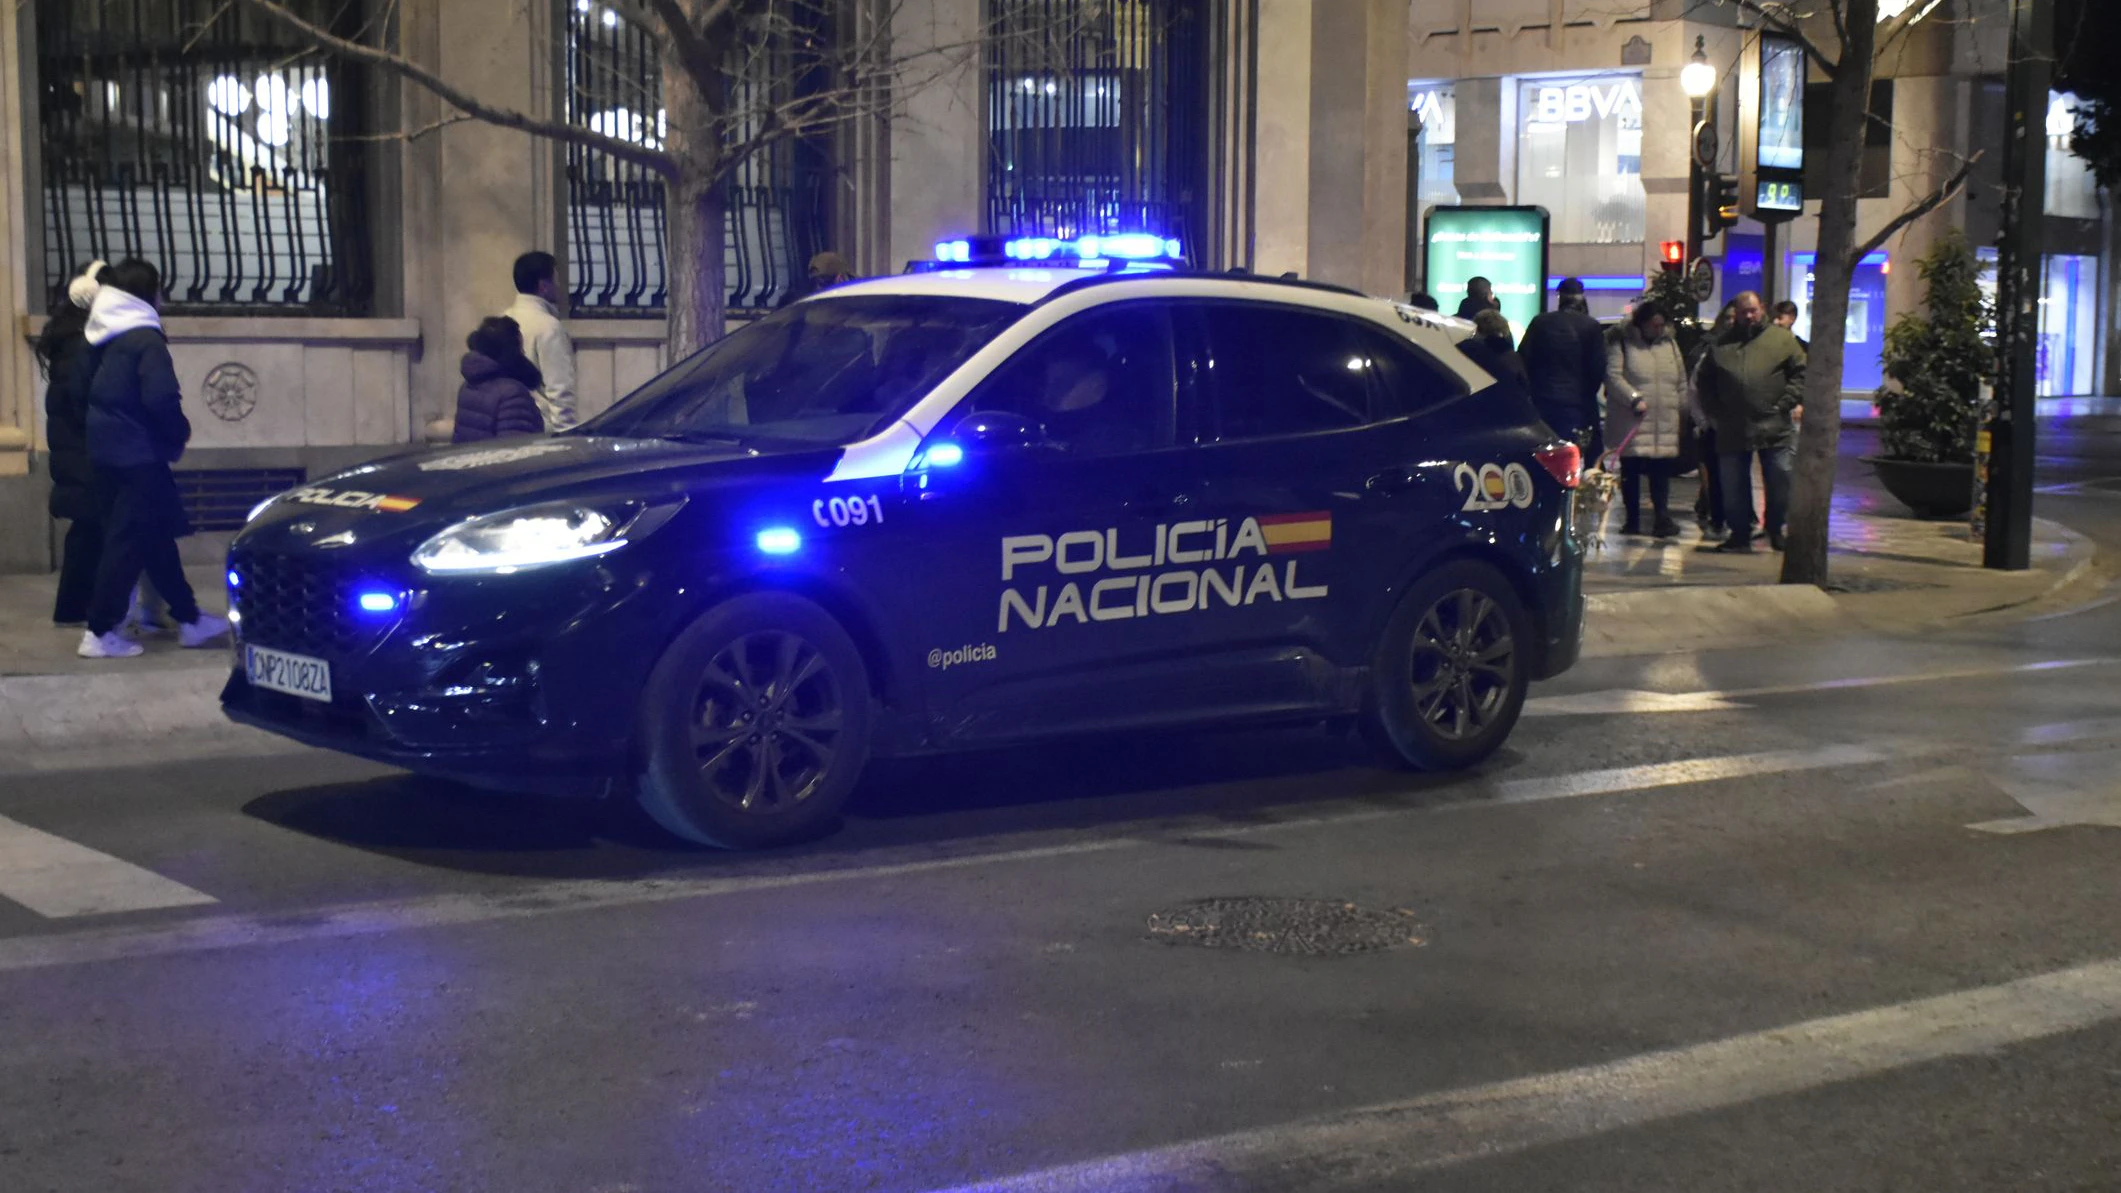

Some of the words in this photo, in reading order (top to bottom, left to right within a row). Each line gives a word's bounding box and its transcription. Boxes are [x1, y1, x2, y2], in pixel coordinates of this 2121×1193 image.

[1538, 80, 1643, 123] BBVA
[1454, 462, 1534, 512] 200
[828, 494, 884, 527] 091
[998, 560, 1329, 633] NACIONAL
[927, 642, 997, 671] @policia
